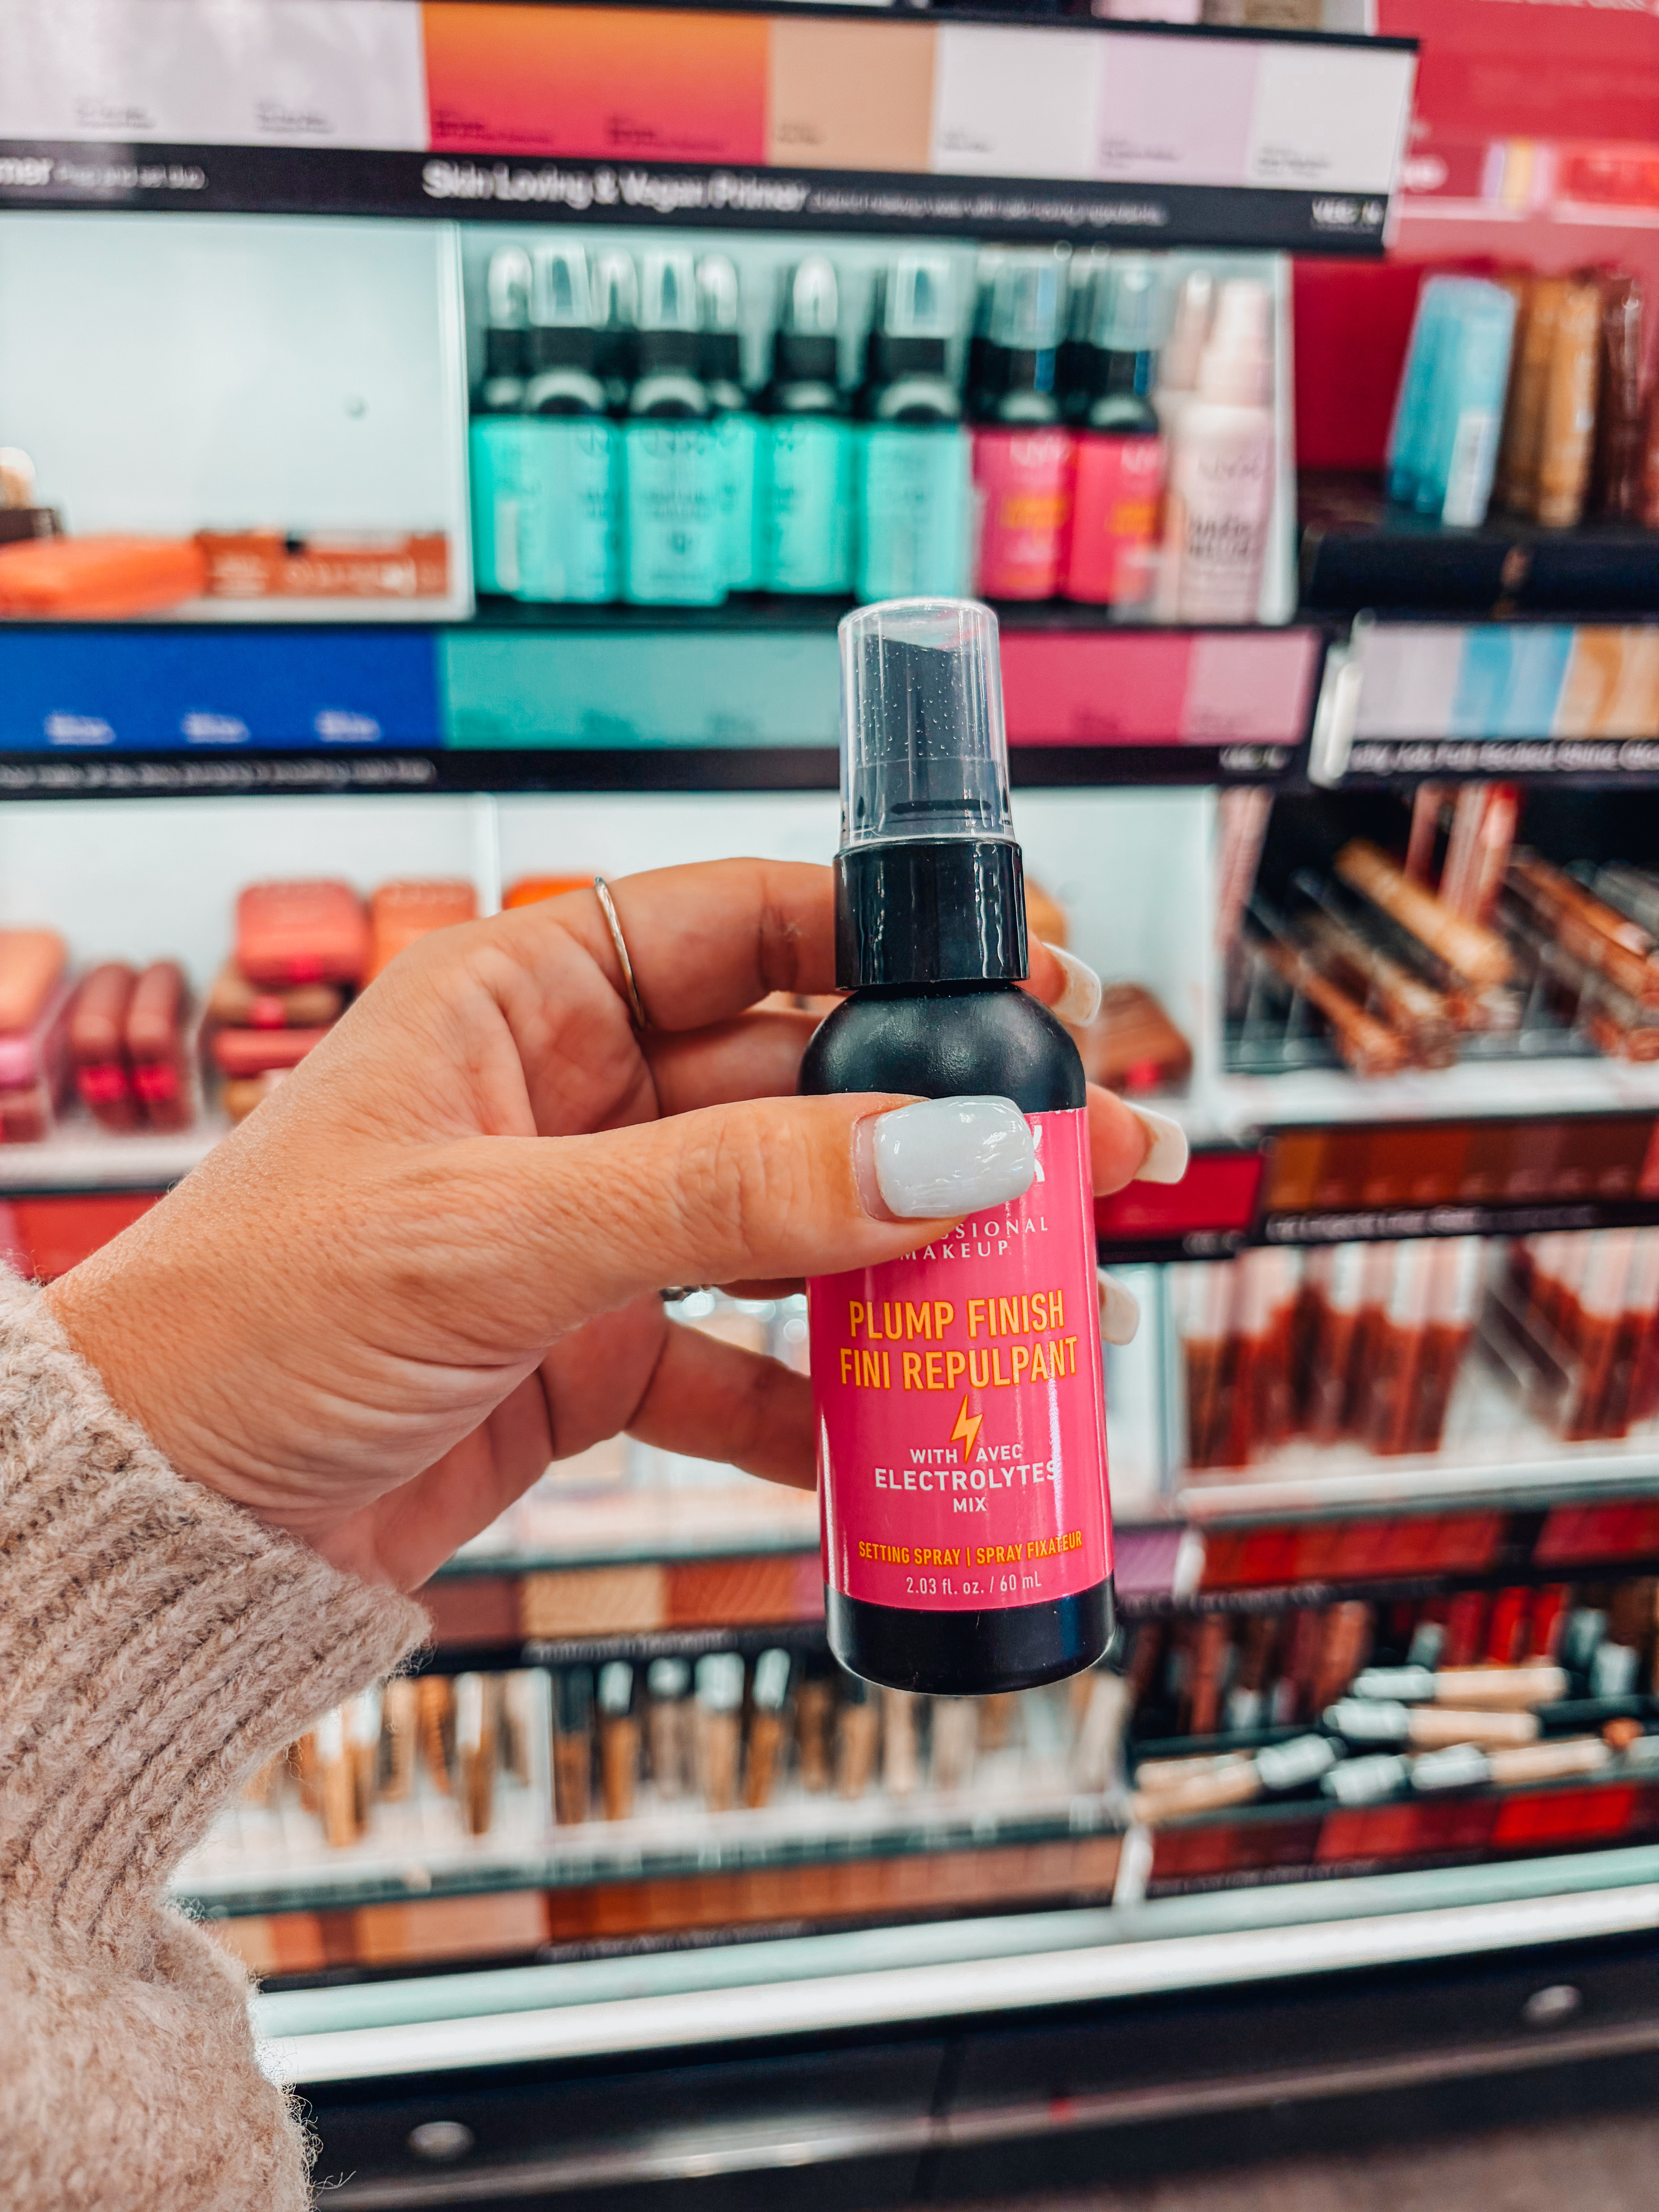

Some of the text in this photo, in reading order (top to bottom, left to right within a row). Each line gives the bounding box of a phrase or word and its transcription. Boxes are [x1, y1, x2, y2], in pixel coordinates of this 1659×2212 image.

[900, 1240, 1008, 1261] MAKEUP
[849, 1290, 1065, 1340] PLUMP FINISH
[840, 1336, 1077, 1391] FINI REPULPANT
[910, 1444, 1022, 1464] WITH AVEC
[875, 1461, 1057, 1491] ELECTROLYTES
[953, 1498, 987, 1513] MIX
[859, 1541, 910, 1565] SETTING
[914, 1549, 960, 1566] SPRAY
[976, 1544, 1022, 1565] SPRAY
[1027, 1530, 1082, 1560] FIXATEUR
[906, 1576, 937, 1594] 2.03
[942, 1577, 958, 1595] fl.
[963, 1582, 984, 1594] oz.
[1000, 1574, 1017, 1592] 60
[1022, 1571, 1042, 1588] mL
